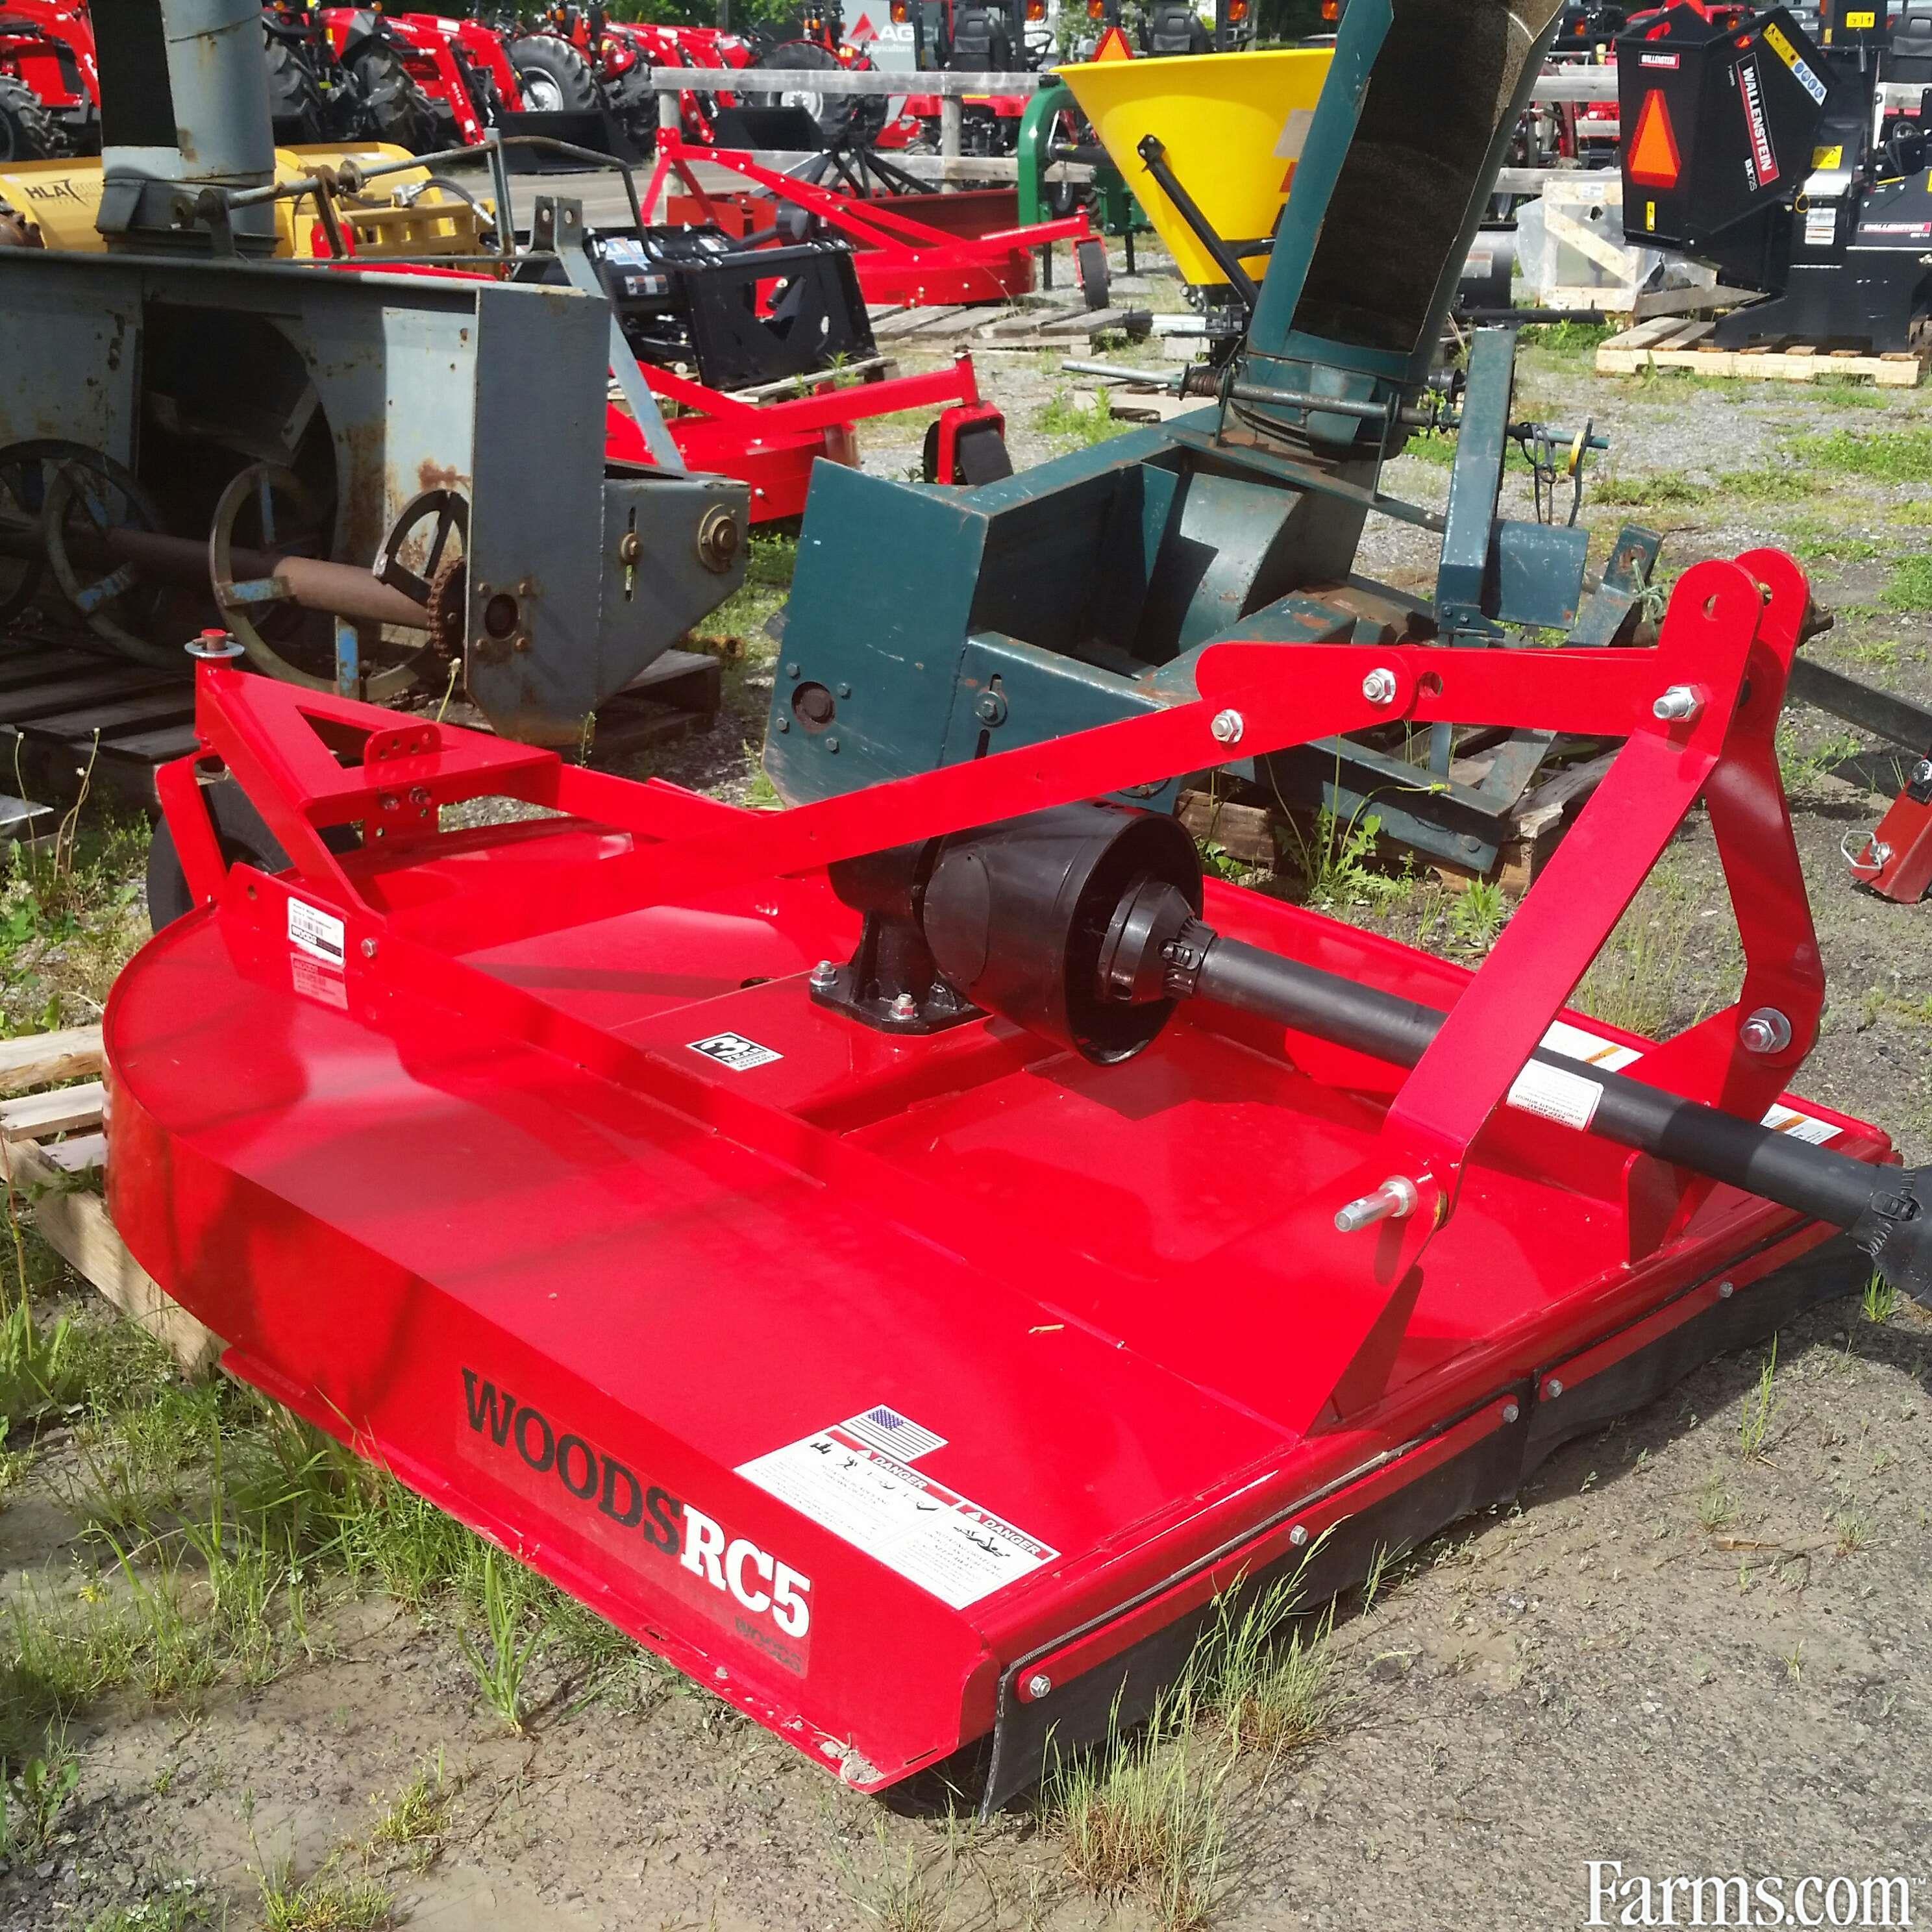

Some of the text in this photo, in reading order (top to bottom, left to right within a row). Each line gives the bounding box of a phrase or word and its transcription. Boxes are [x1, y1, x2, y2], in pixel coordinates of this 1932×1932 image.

[879, 24, 939, 42] AGC
[1742, 66, 1773, 171] WALLENSTEIN
[24, 185, 69, 199] HLA
[700, 1037, 751, 1056] 3
[722, 1048, 763, 1061] YEAR
[871, 1455, 929, 1490] DANGER
[461, 1365, 680, 1555] WOODS
[680, 1503, 811, 1638] RC5
[983, 1518, 1043, 1555] DANGER
